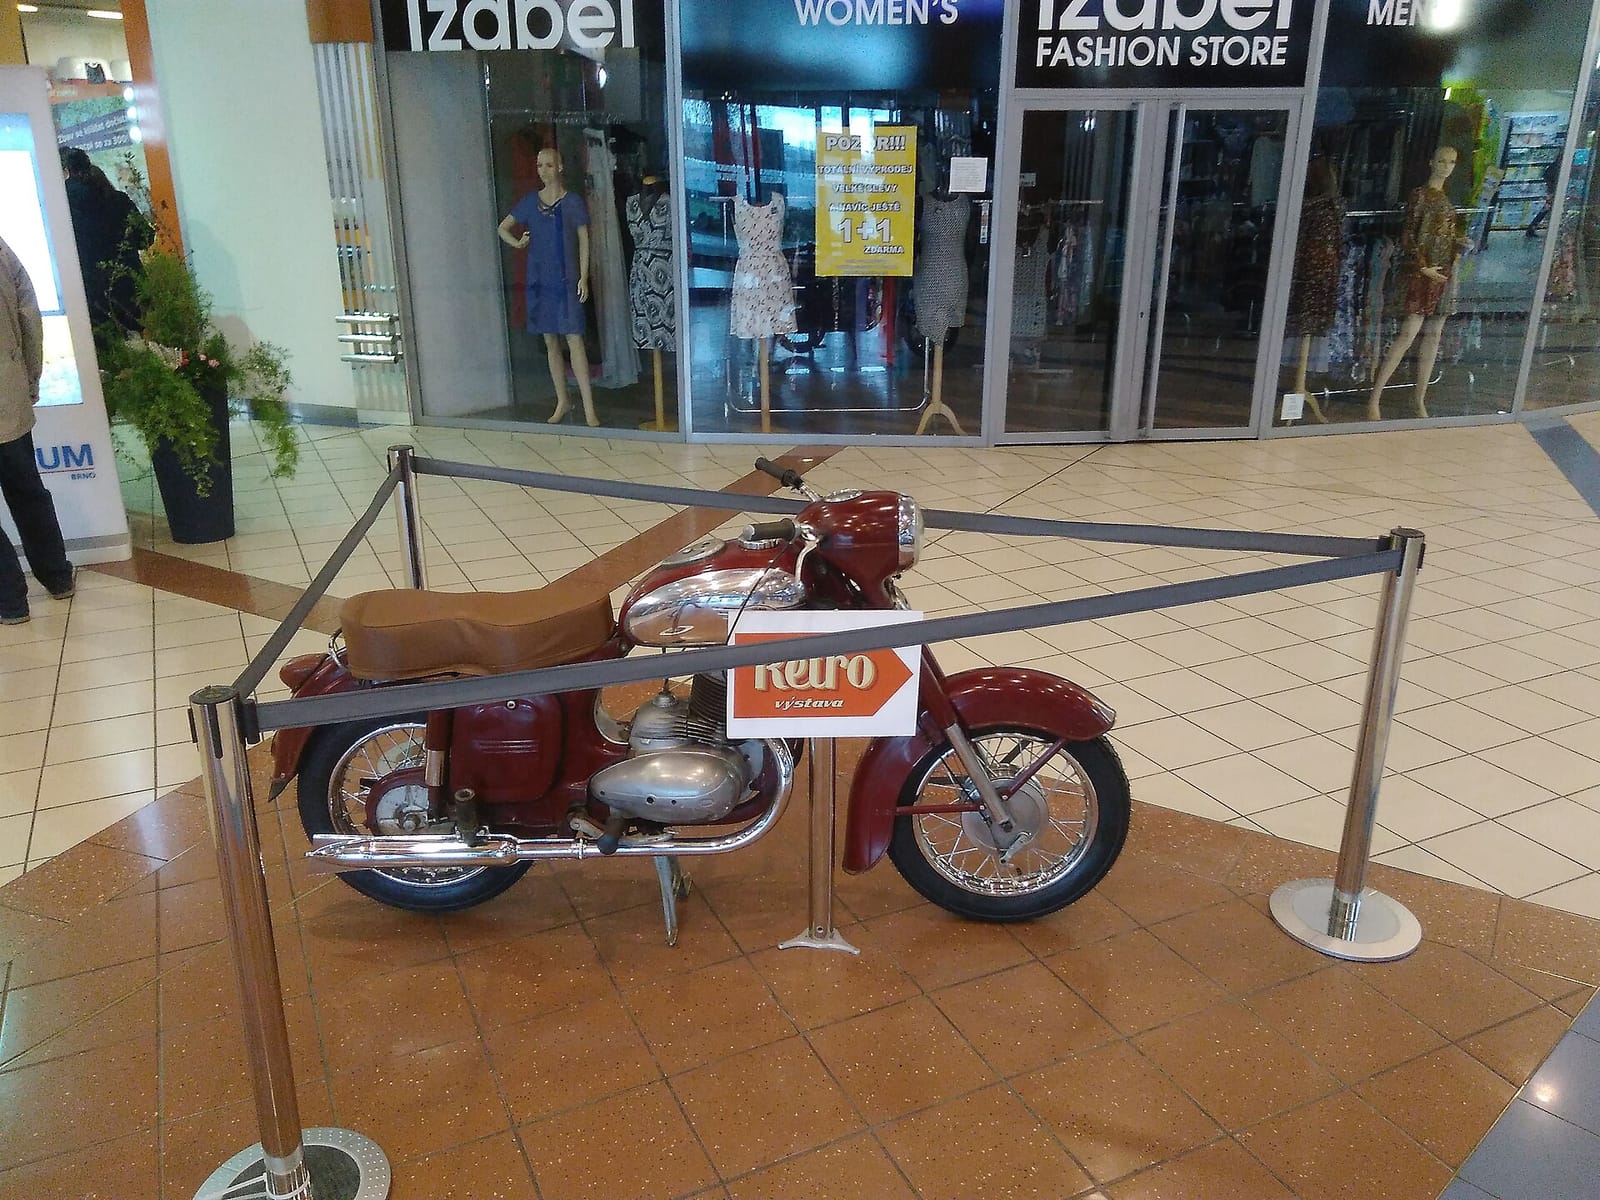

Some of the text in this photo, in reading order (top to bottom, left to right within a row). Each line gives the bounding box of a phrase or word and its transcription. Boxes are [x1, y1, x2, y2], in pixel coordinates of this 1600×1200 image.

[794, 0, 959, 25] WOMEN'S
[1036, 35, 1289, 67] FASHION STORE
[825, 135, 906, 151] POZR!!!
[864, 245, 905, 255] ZDARMA
[71, 472, 96, 480] BRNO
[774, 696, 844, 711] výstava
